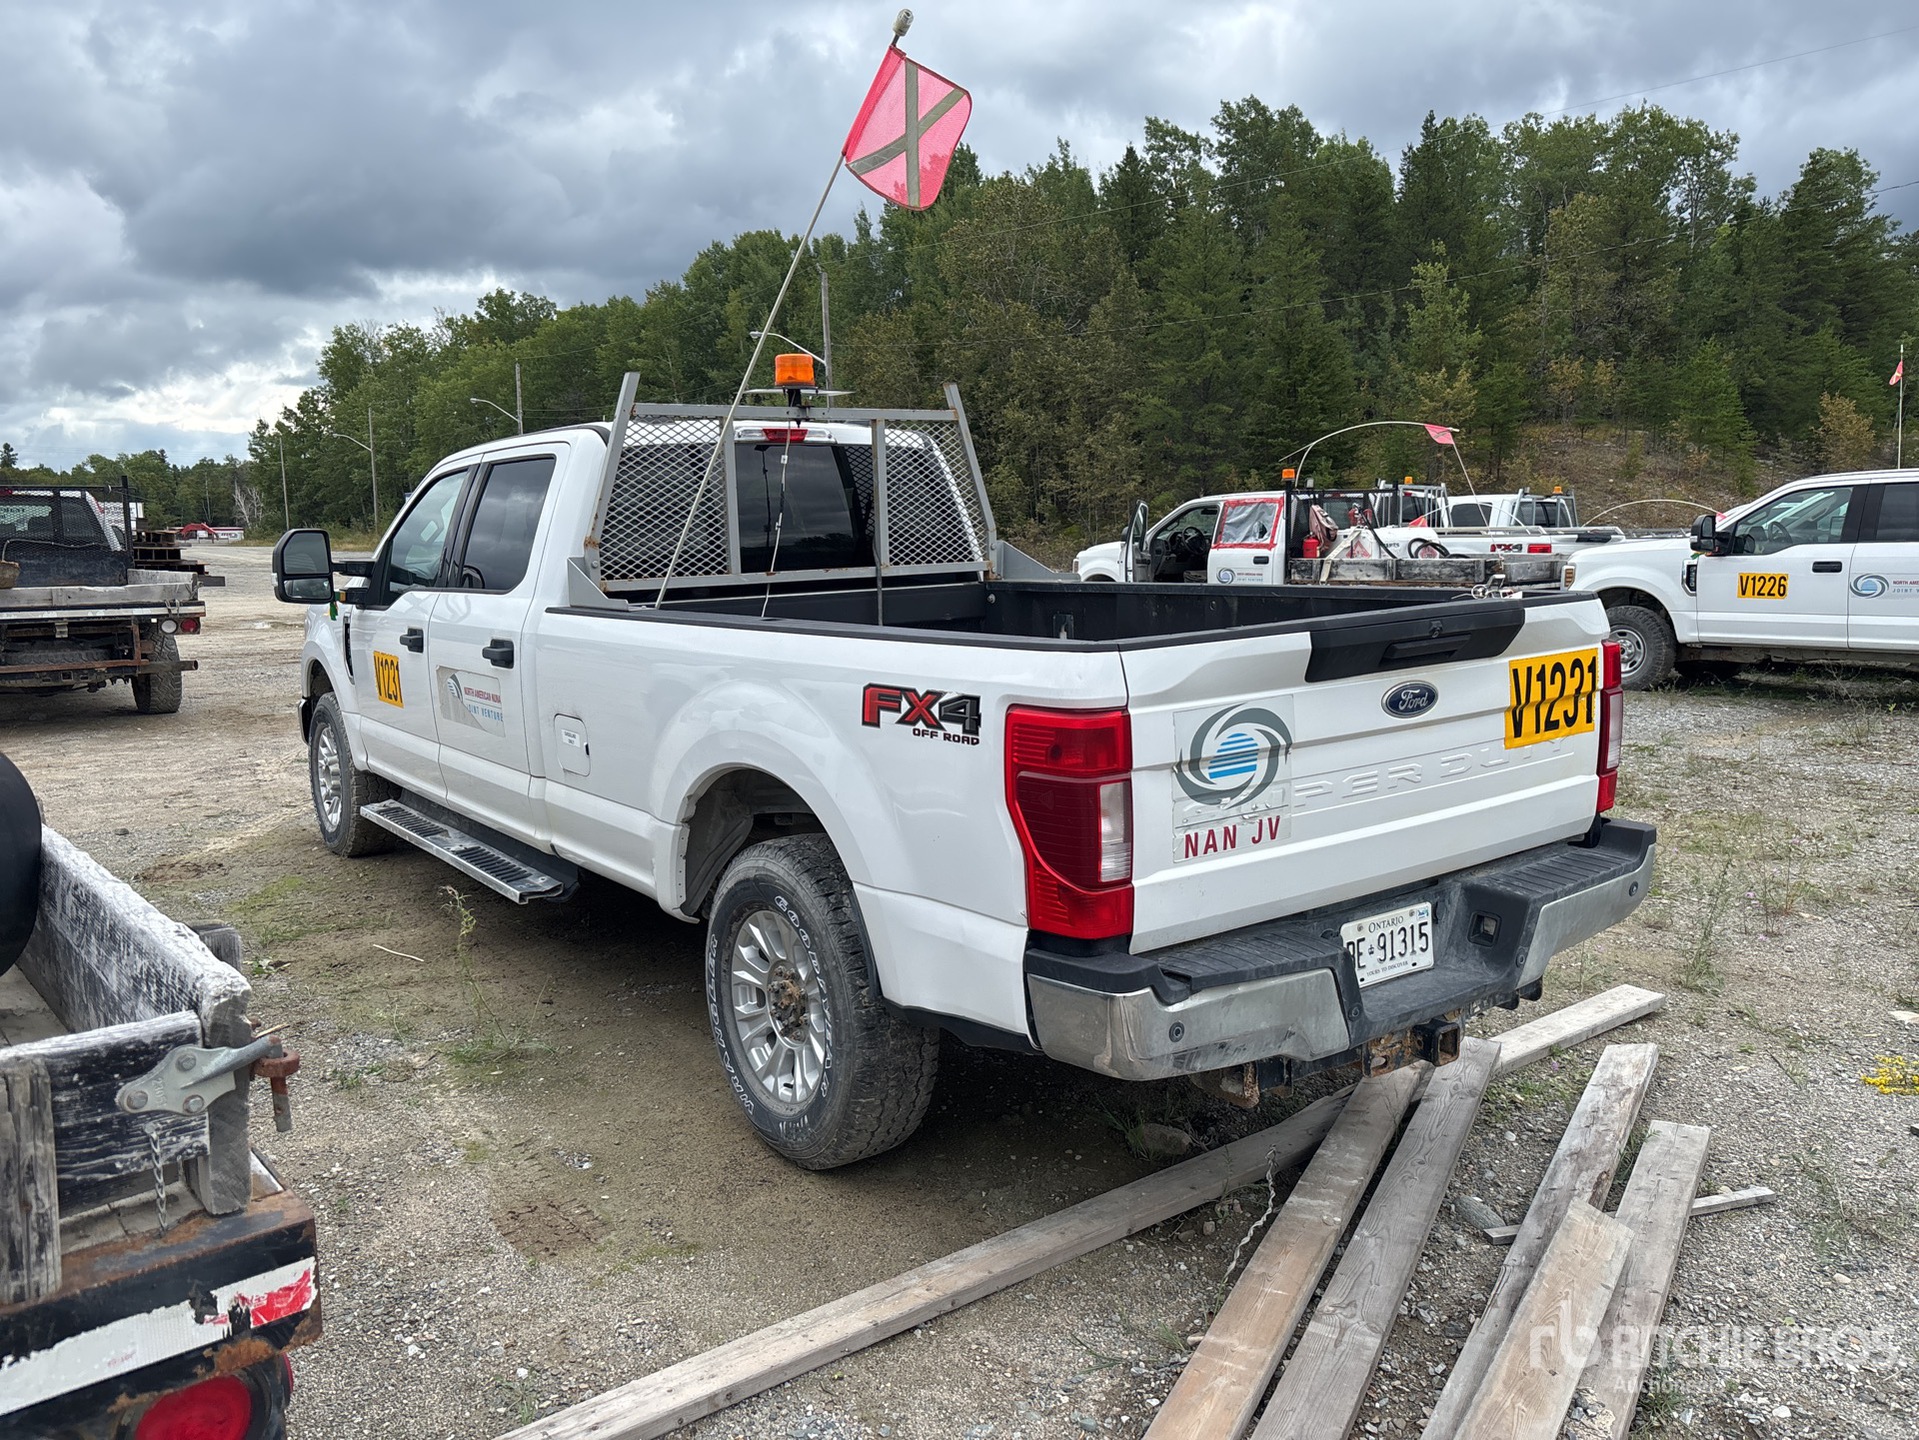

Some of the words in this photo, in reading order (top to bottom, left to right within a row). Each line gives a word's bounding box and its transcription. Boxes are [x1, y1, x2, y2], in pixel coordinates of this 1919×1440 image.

[1739, 575, 1787, 597] V1226
[374, 655, 403, 704] V1231
[1398, 688, 1429, 711] Ford
[1512, 656, 1597, 739] V1231
[862, 683, 981, 736] FX4
[912, 728, 939, 739] OFF
[943, 732, 980, 746] ROAD
[1184, 824, 1237, 859] NAN
[1251, 815, 1281, 844] JV
[1368, 915, 1404, 934] ONTARIO
[1377, 921, 1429, 964] 91315
[709, 933, 755, 1116] WRANGLER
